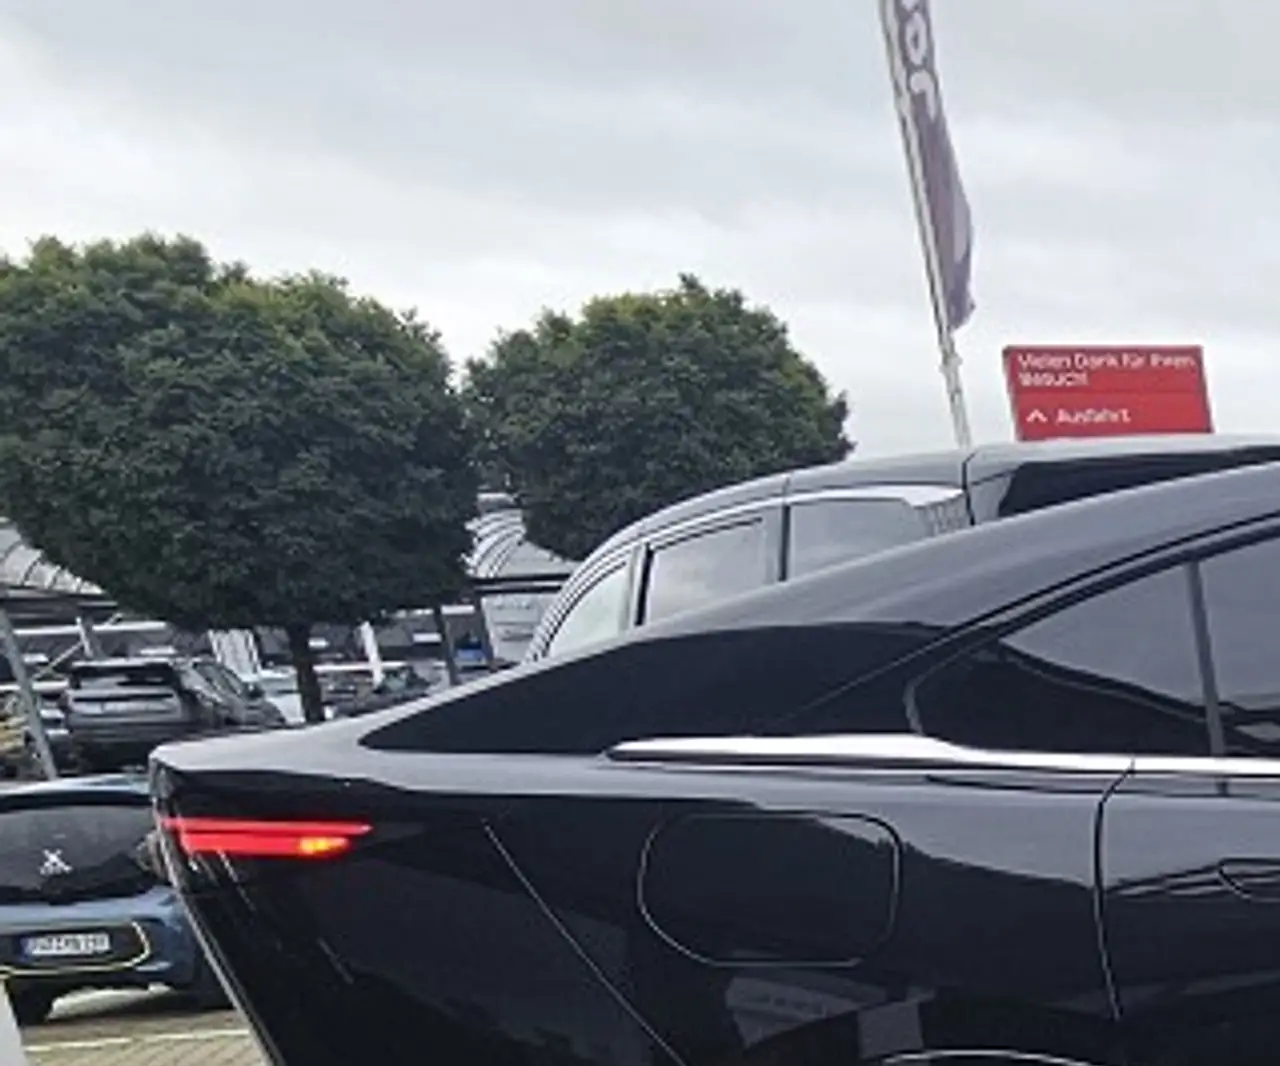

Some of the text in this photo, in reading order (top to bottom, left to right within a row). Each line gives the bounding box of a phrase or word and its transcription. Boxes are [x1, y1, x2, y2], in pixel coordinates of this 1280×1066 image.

[1018, 352, 1071, 371] Vielen
[1074, 352, 1118, 370] Dank
[1121, 352, 1146, 370] für
